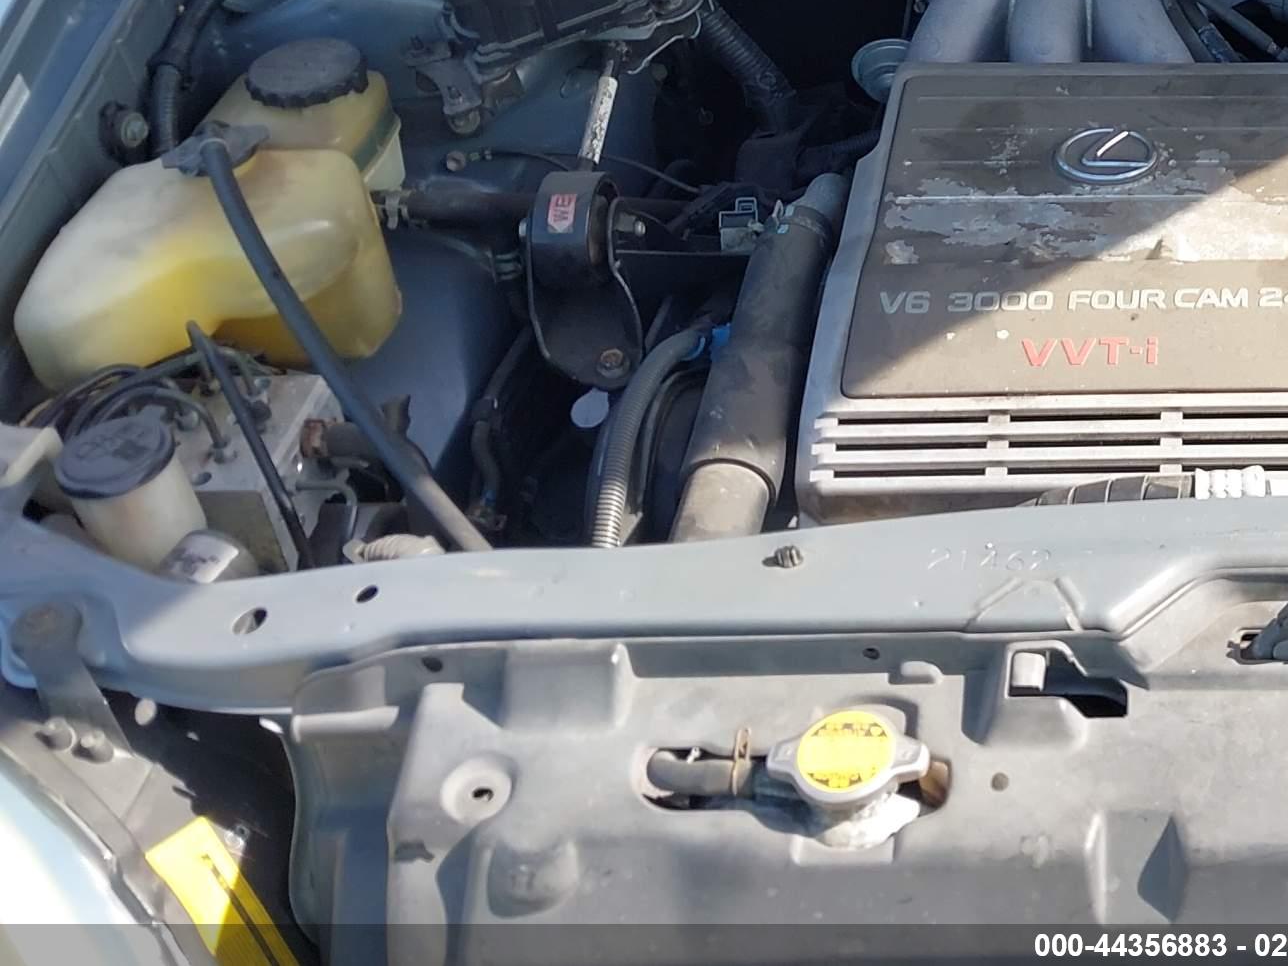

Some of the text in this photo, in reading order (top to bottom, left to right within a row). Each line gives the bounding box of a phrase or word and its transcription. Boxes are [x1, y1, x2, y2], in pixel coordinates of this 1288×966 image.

[879, 290, 931, 314] V6
[946, 290, 1054, 313] 3000
[1067, 289, 1167, 311] FOUR
[1173, 286, 1249, 309] CAM
[1021, 336, 1159, 367] VVT-i
